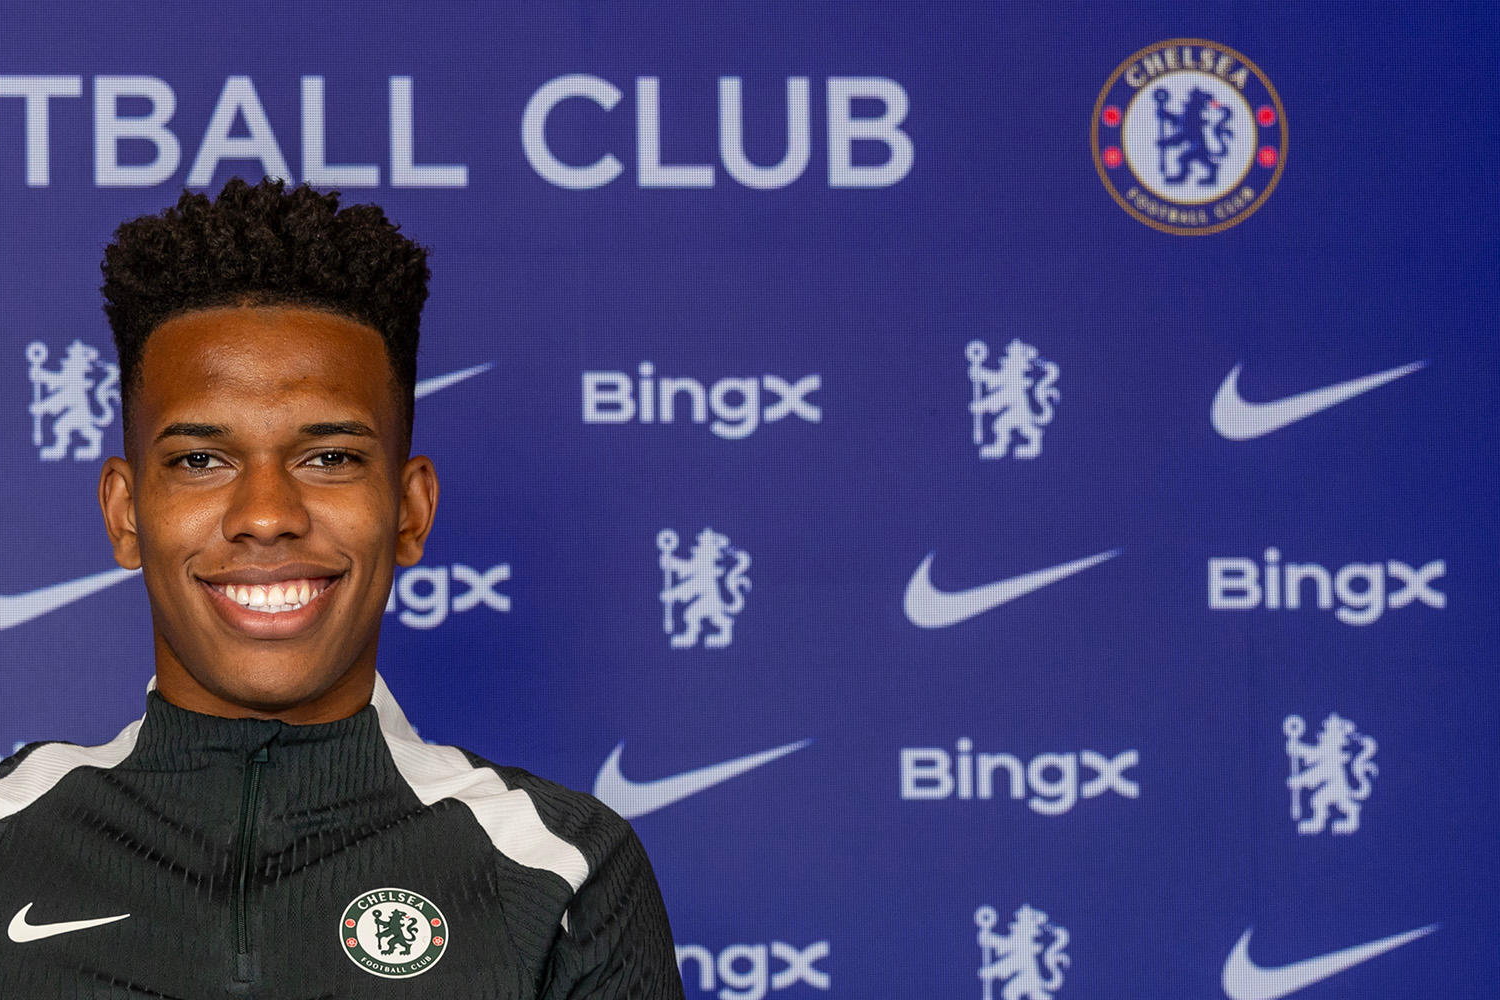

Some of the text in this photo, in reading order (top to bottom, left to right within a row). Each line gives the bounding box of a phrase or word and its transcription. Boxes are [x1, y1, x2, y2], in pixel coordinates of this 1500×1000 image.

[1124, 46, 1249, 89] CHELSEA
[520, 74, 915, 189] CLUB
[357, 892, 425, 911] CHELSEA
[360, 955, 432, 973] FOOTBALL CLUB
